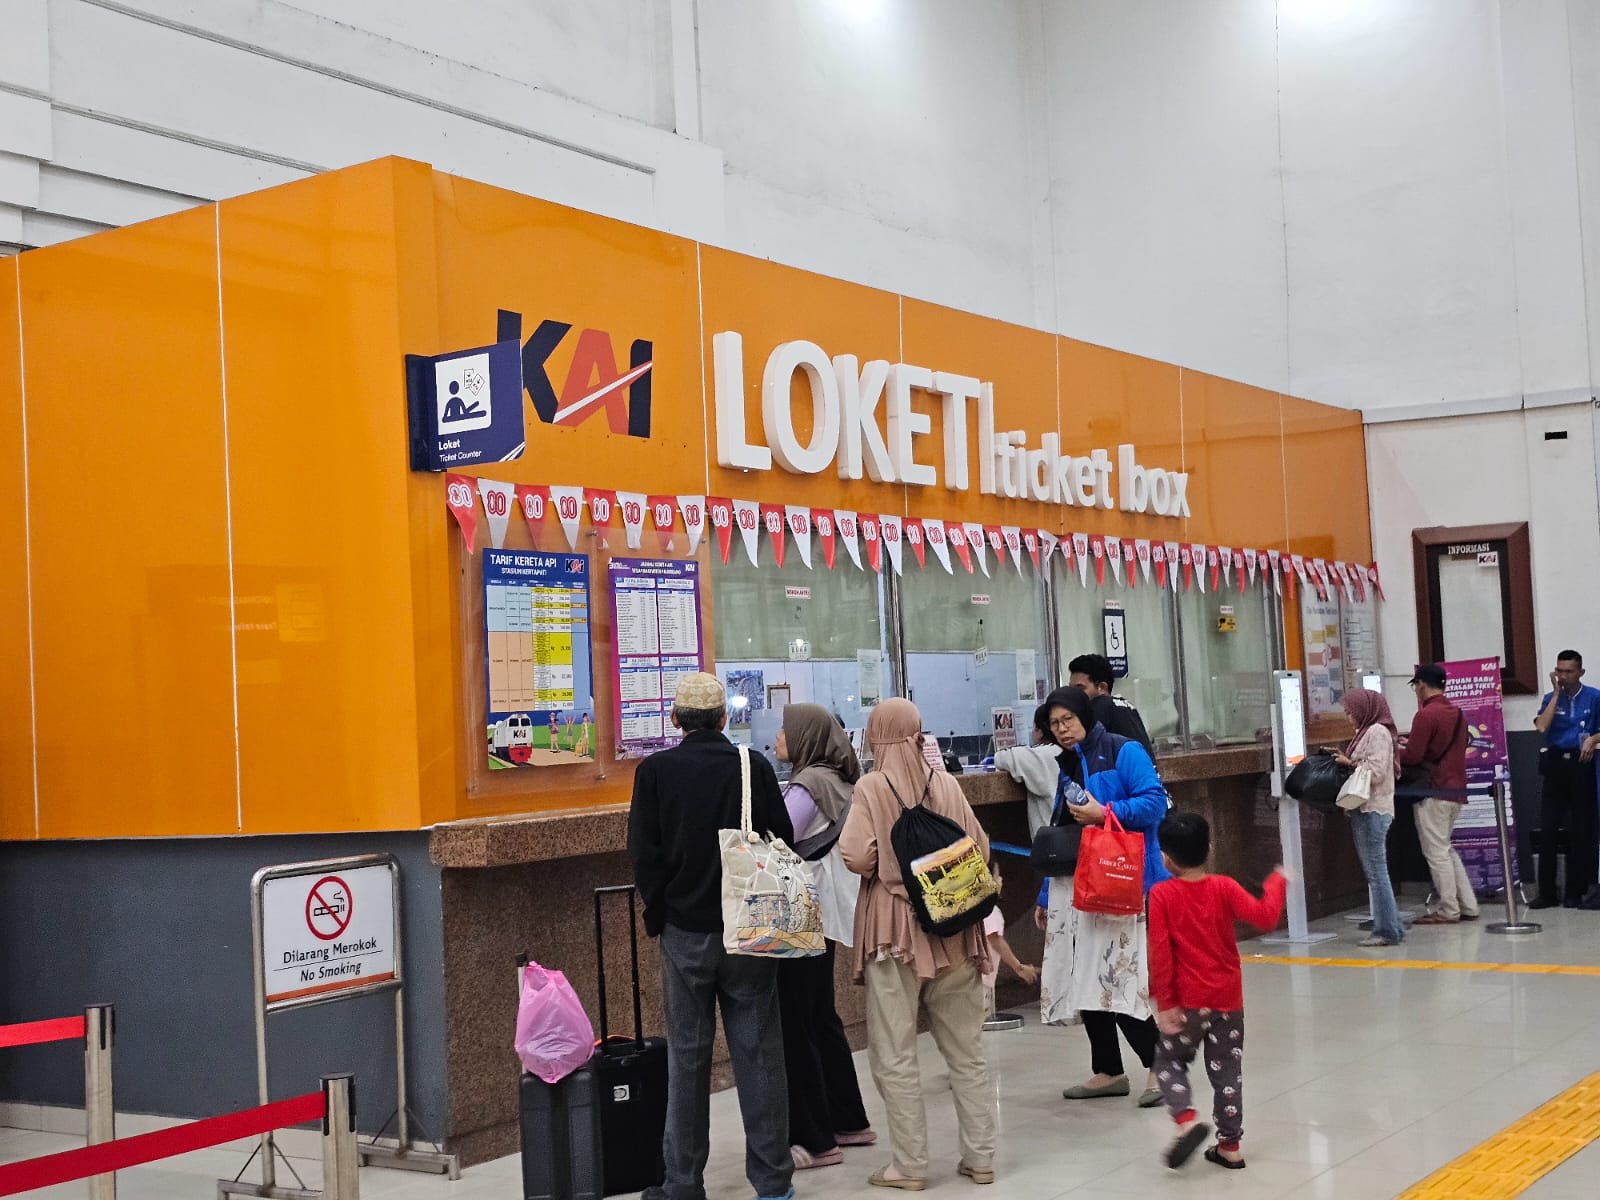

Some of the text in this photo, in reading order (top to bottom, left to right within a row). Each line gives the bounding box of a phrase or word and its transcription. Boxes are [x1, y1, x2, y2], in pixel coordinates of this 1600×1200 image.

[497, 308, 653, 439] KAI
[713, 330, 1191, 517] LOKET ticket box
[438, 438, 461, 451] Loket
[439, 450, 482, 463] Ticket Counter
[448, 483, 473, 508] 80
[487, 490, 506, 516] 80
[525, 494, 543, 519] 80
[1448, 543, 1490, 555] INFORMASI
[490, 554, 557, 568] TARIF KERETA API
[565, 558, 585, 573] KAI
[1478, 554, 1496, 564] KAI
[1481, 663, 1496, 671] KAI
[994, 713, 1013, 729] KAI
[513, 729, 526, 739] KAI
[283, 937, 377, 965] Dilarang Merokok
[300, 961, 362, 983] No Smoking
